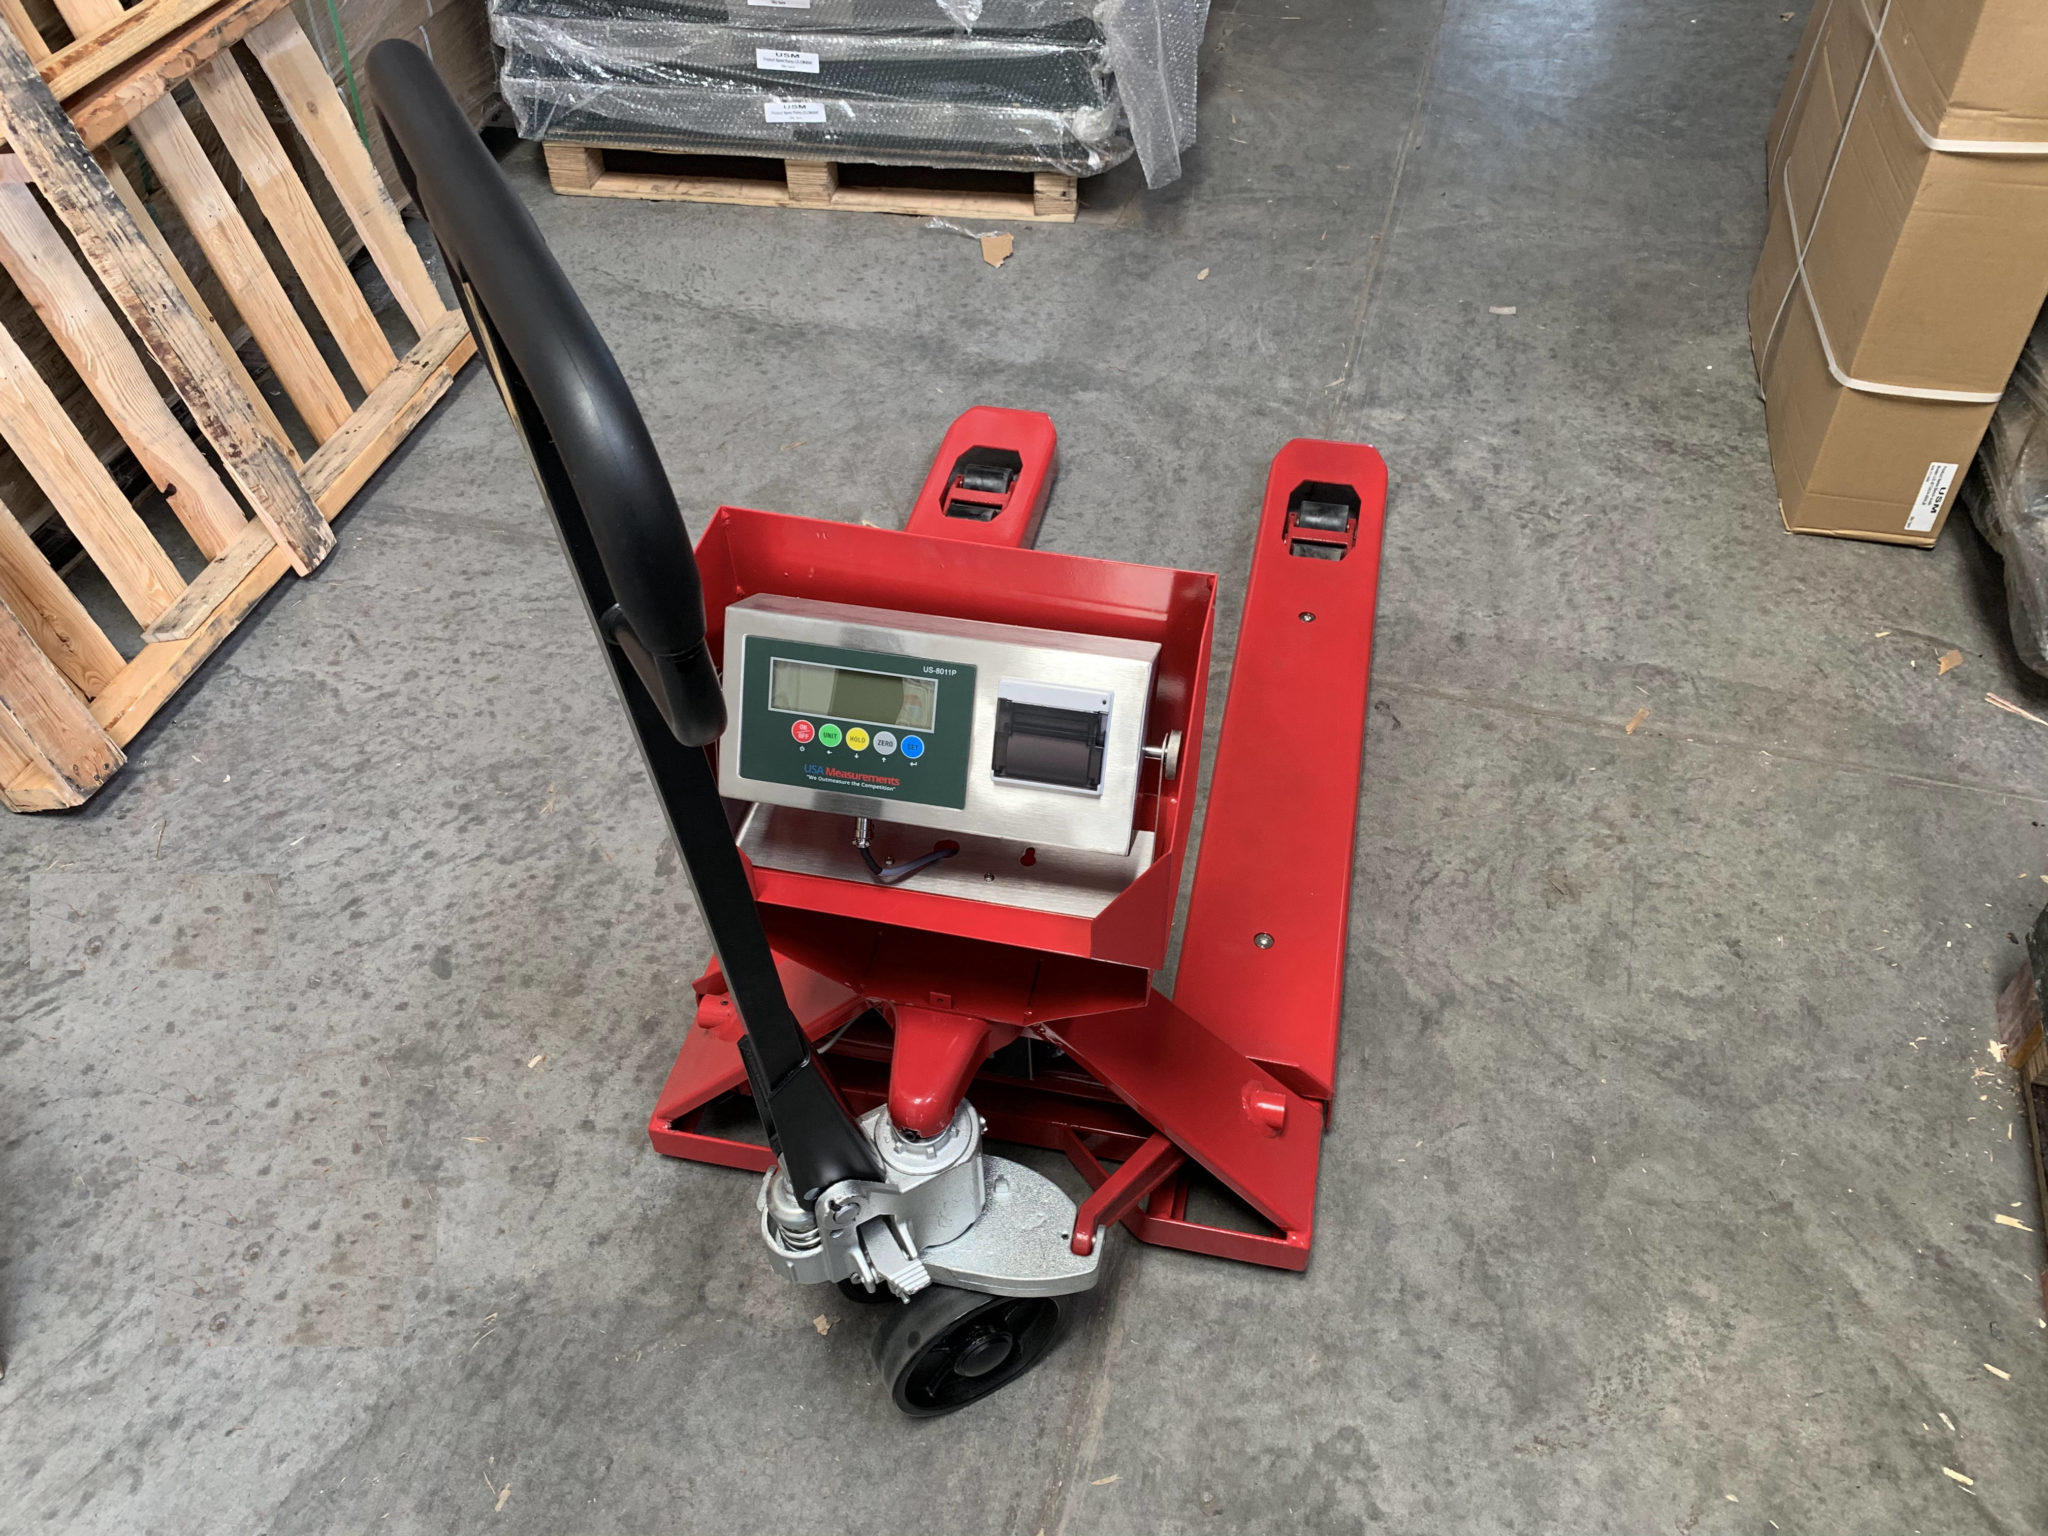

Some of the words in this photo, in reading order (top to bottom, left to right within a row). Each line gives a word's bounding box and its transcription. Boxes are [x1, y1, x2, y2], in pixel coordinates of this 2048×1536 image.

[1930, 487, 1947, 514] USM
[923, 665, 957, 676] US-8011P
[823, 732, 838, 740] UNIT
[849, 736, 866, 744] HOLD
[877, 740, 893, 748] ZERO
[907, 743, 919, 751] SET
[804, 763, 824, 775] USA
[825, 767, 901, 786] Measurements
[817, 776, 850, 786] Outmeasure
